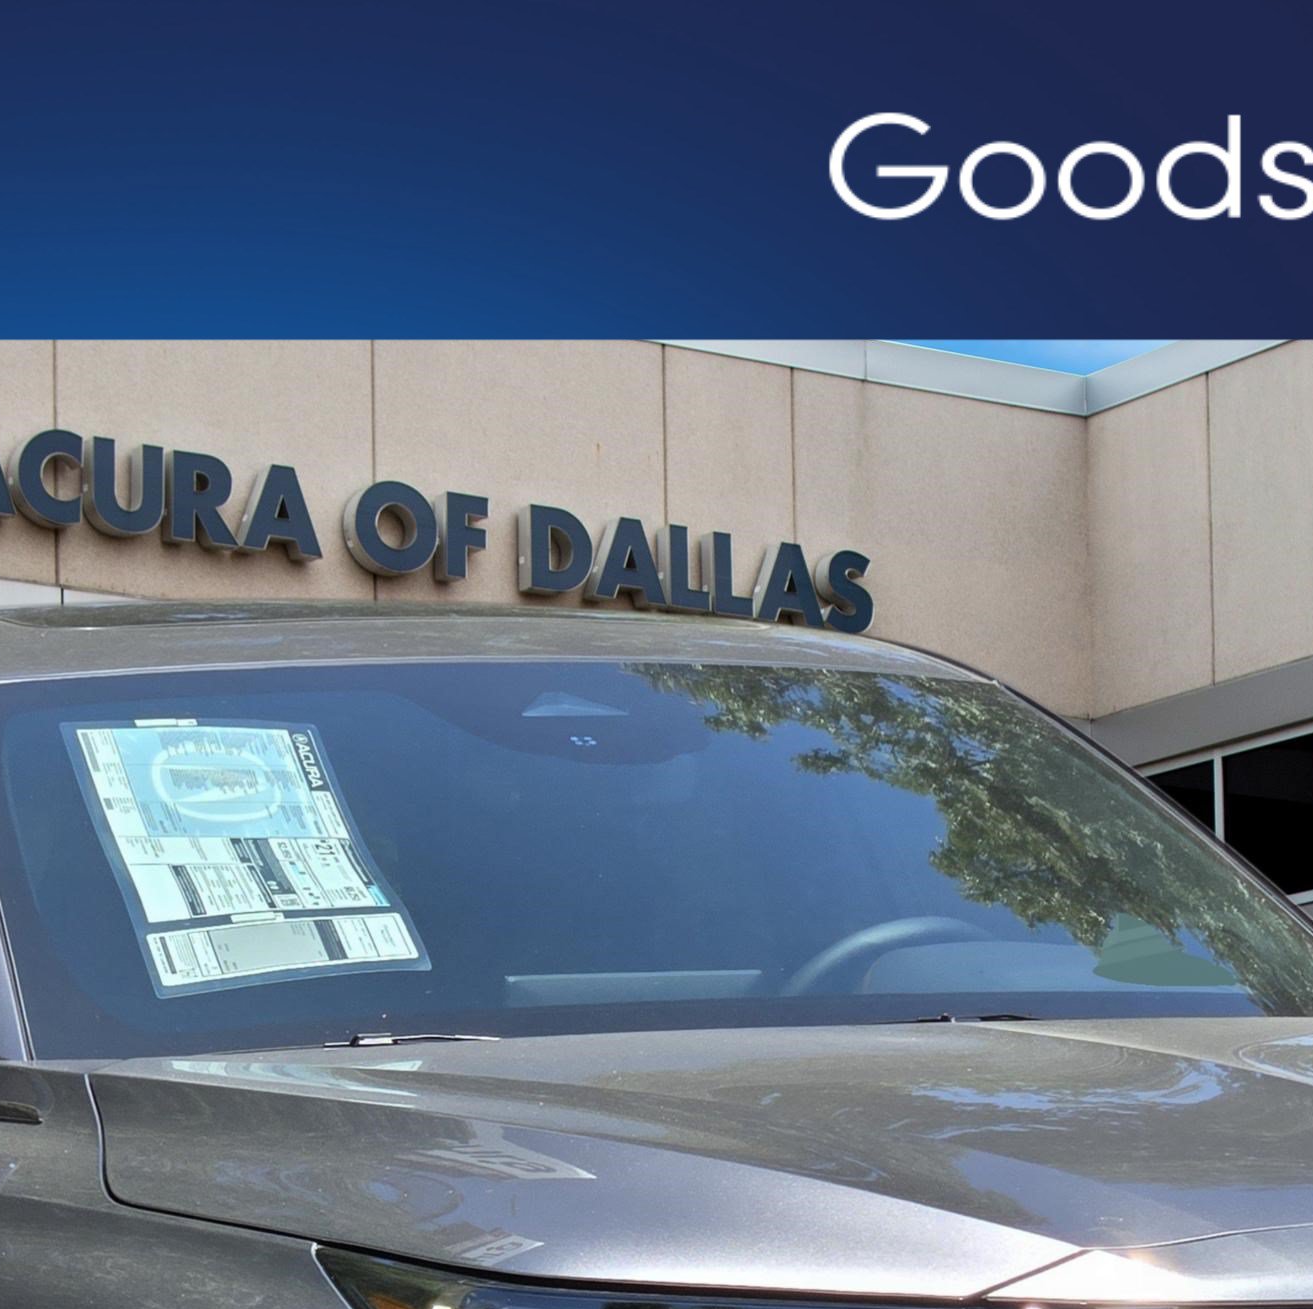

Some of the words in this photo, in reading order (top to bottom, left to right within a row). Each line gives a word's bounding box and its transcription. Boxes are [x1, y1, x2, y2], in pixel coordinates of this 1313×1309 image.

[343, 480, 488, 584] OF
[517, 503, 875, 634] DALLAS
[292, 741, 325, 791] ACURA
